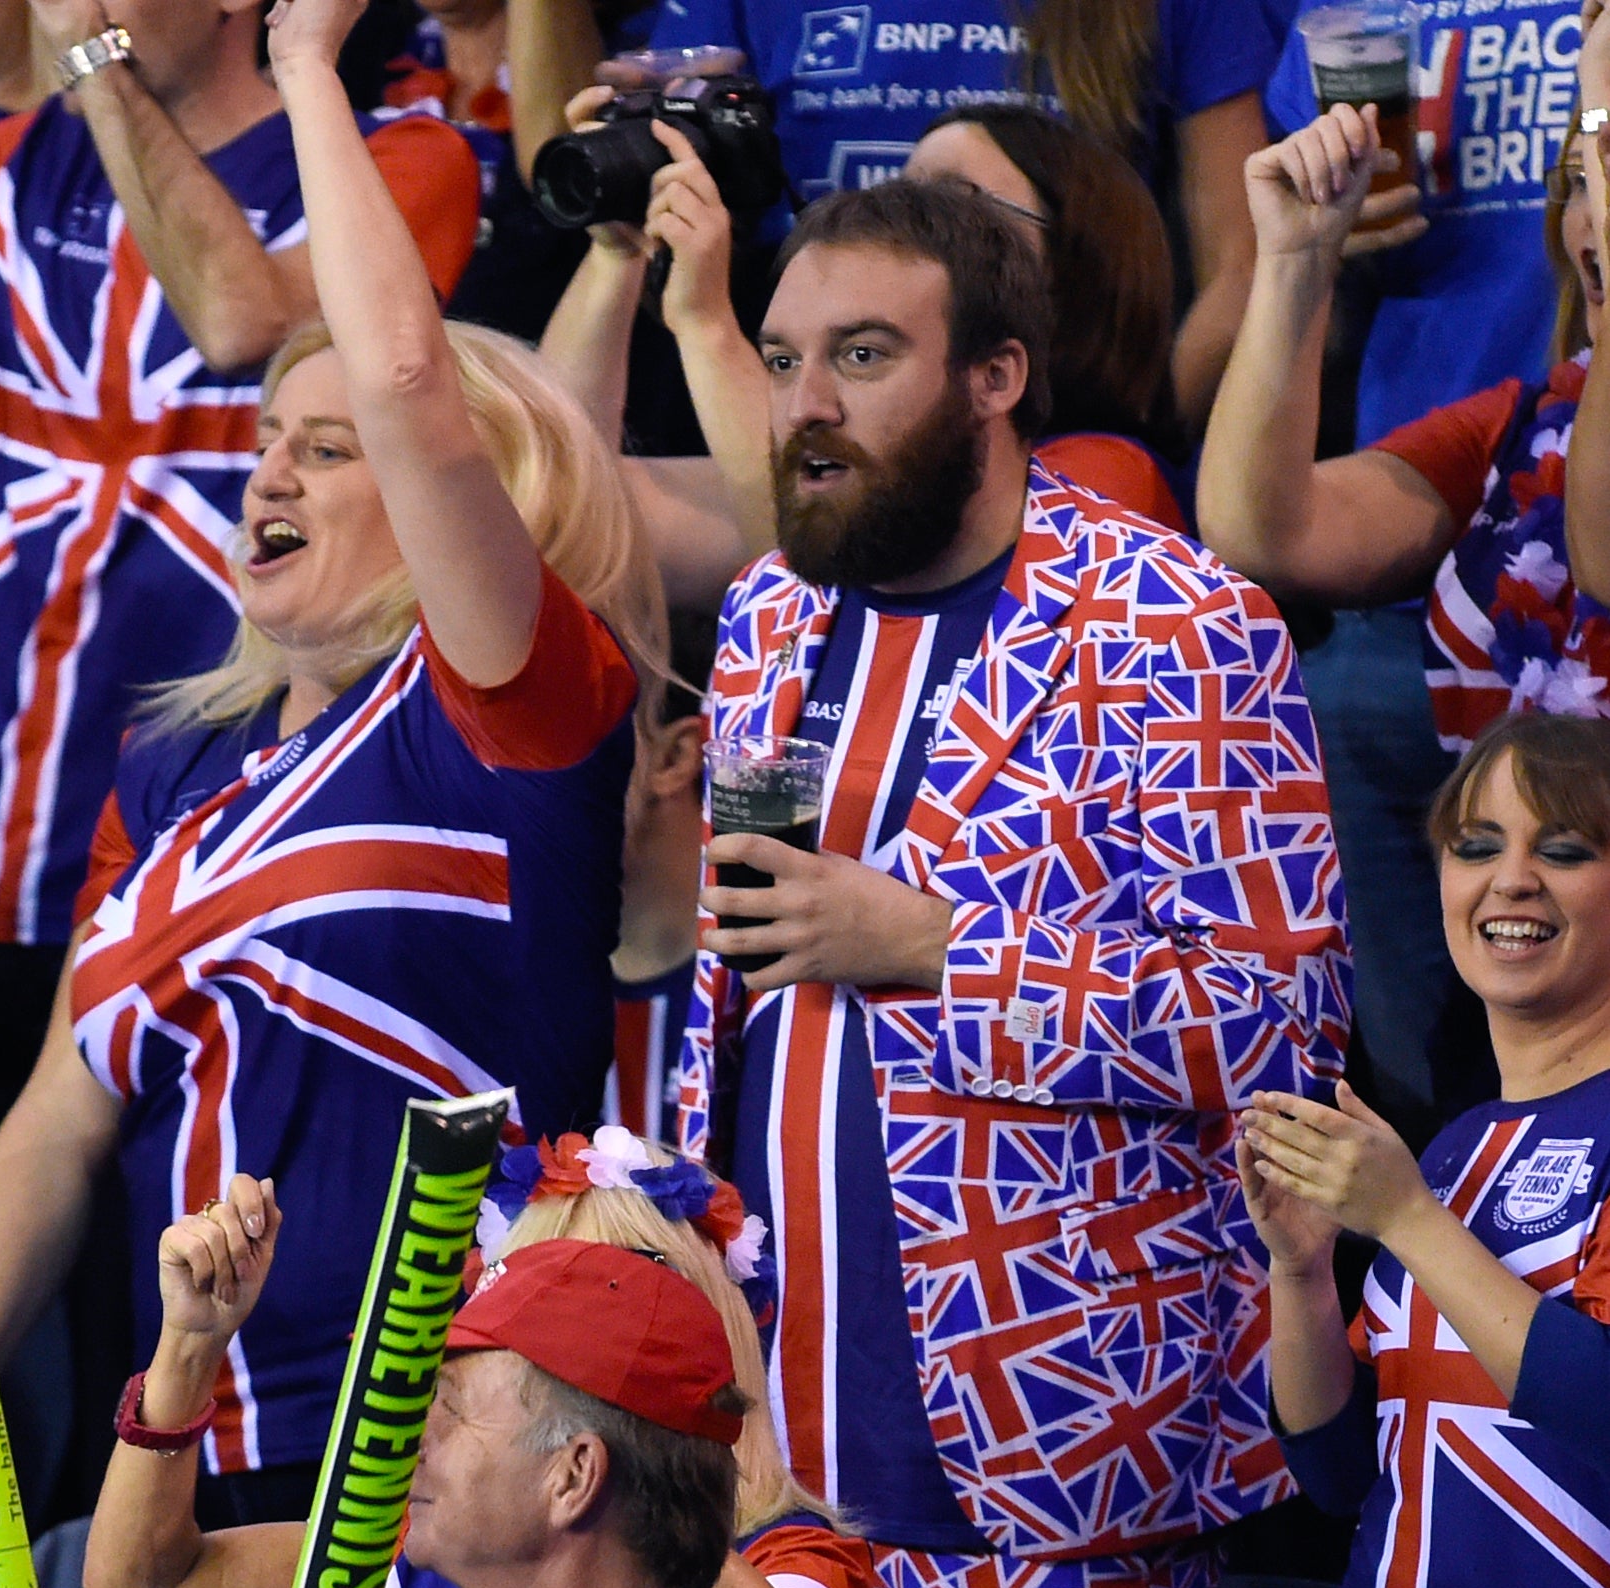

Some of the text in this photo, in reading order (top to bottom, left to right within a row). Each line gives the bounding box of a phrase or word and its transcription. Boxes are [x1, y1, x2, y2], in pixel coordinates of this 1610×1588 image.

[874, 23, 956, 51] BNP
[1466, 14, 1582, 80] BAC
[791, 89, 828, 110] The
[831, 84, 882, 108] bank
[886, 82, 924, 111] for
[925, 92, 941, 107] a
[1463, 70, 1576, 133] THE
[1459, 126, 1569, 191] BRI
[1530, 1154, 1577, 1175] WE ARE
[1517, 1174, 1565, 1196] TENNIS
[6, 1477, 22, 1523] The
